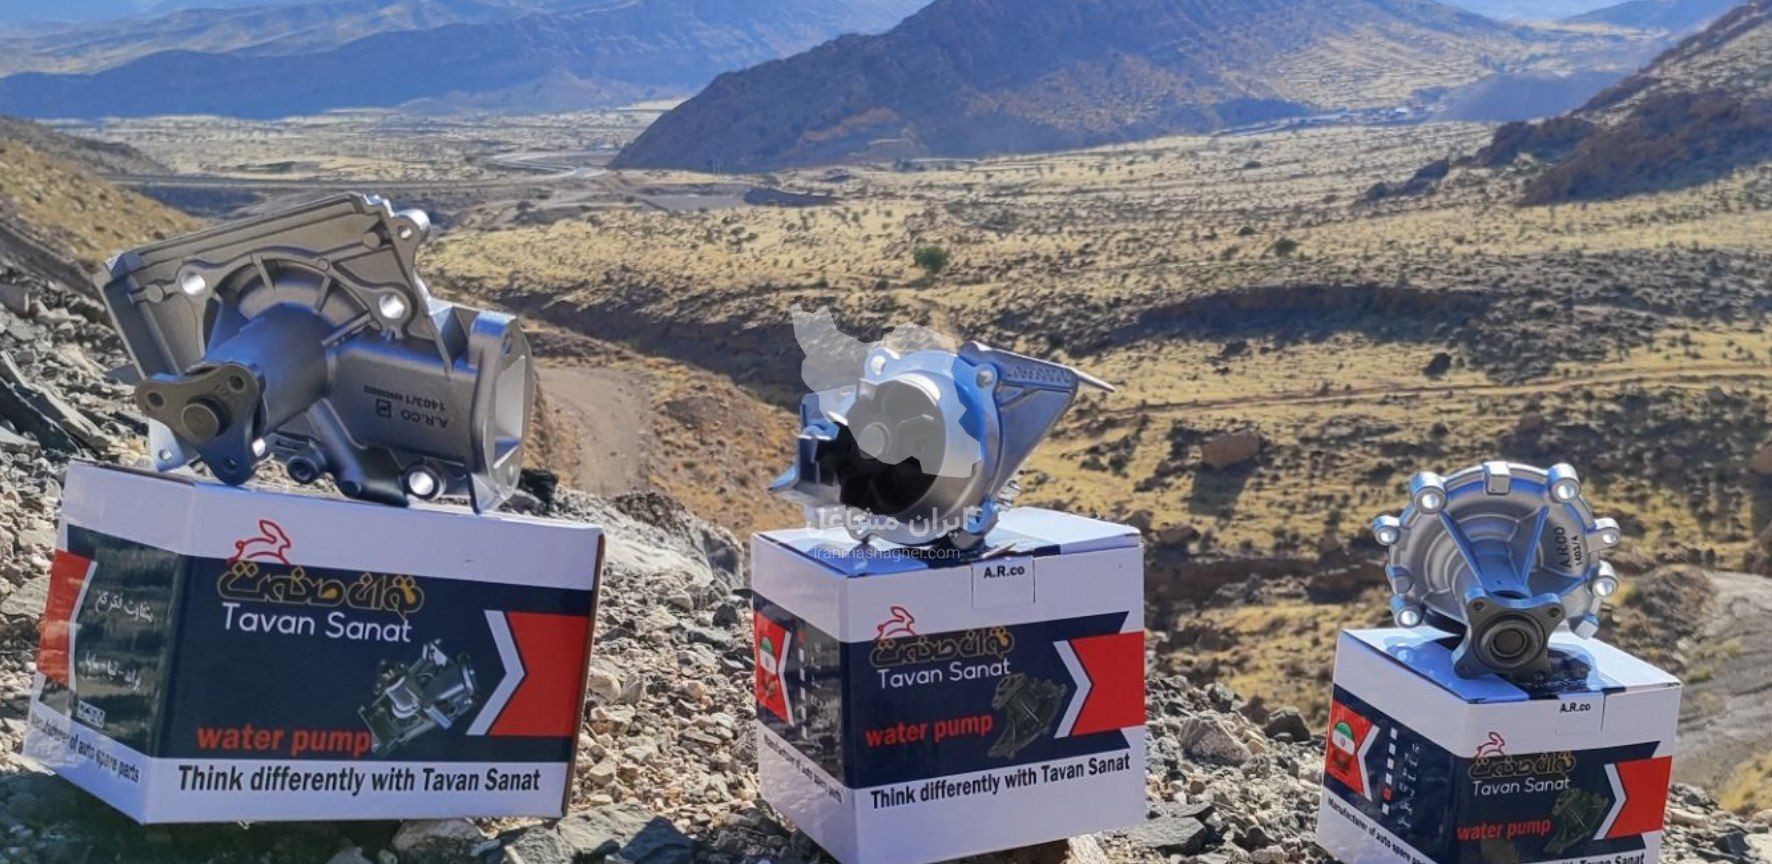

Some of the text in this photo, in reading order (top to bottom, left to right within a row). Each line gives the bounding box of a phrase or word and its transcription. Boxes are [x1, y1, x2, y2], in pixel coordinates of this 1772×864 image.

[406, 395, 446, 412] 1403/1
[401, 409, 448, 429] A.R.CO
[983, 565, 1025, 579] A.R.co
[217, 560, 424, 619] توان صنعت
[222, 602, 412, 643] Tavan Sanat
[877, 658, 1011, 689] Tavan Sanat
[1559, 701, 1591, 713] A.R.co
[197, 723, 372, 757] water pump
[866, 714, 993, 747] water pump
[118, 761, 140, 784] parts
[178, 765, 541, 797] Think differently with Tavan Sanat
[870, 753, 1131, 809] Think differently with Tavan Sanat
[1472, 776, 1571, 796] Tavan Sanat
[1456, 818, 1552, 841] water pump
